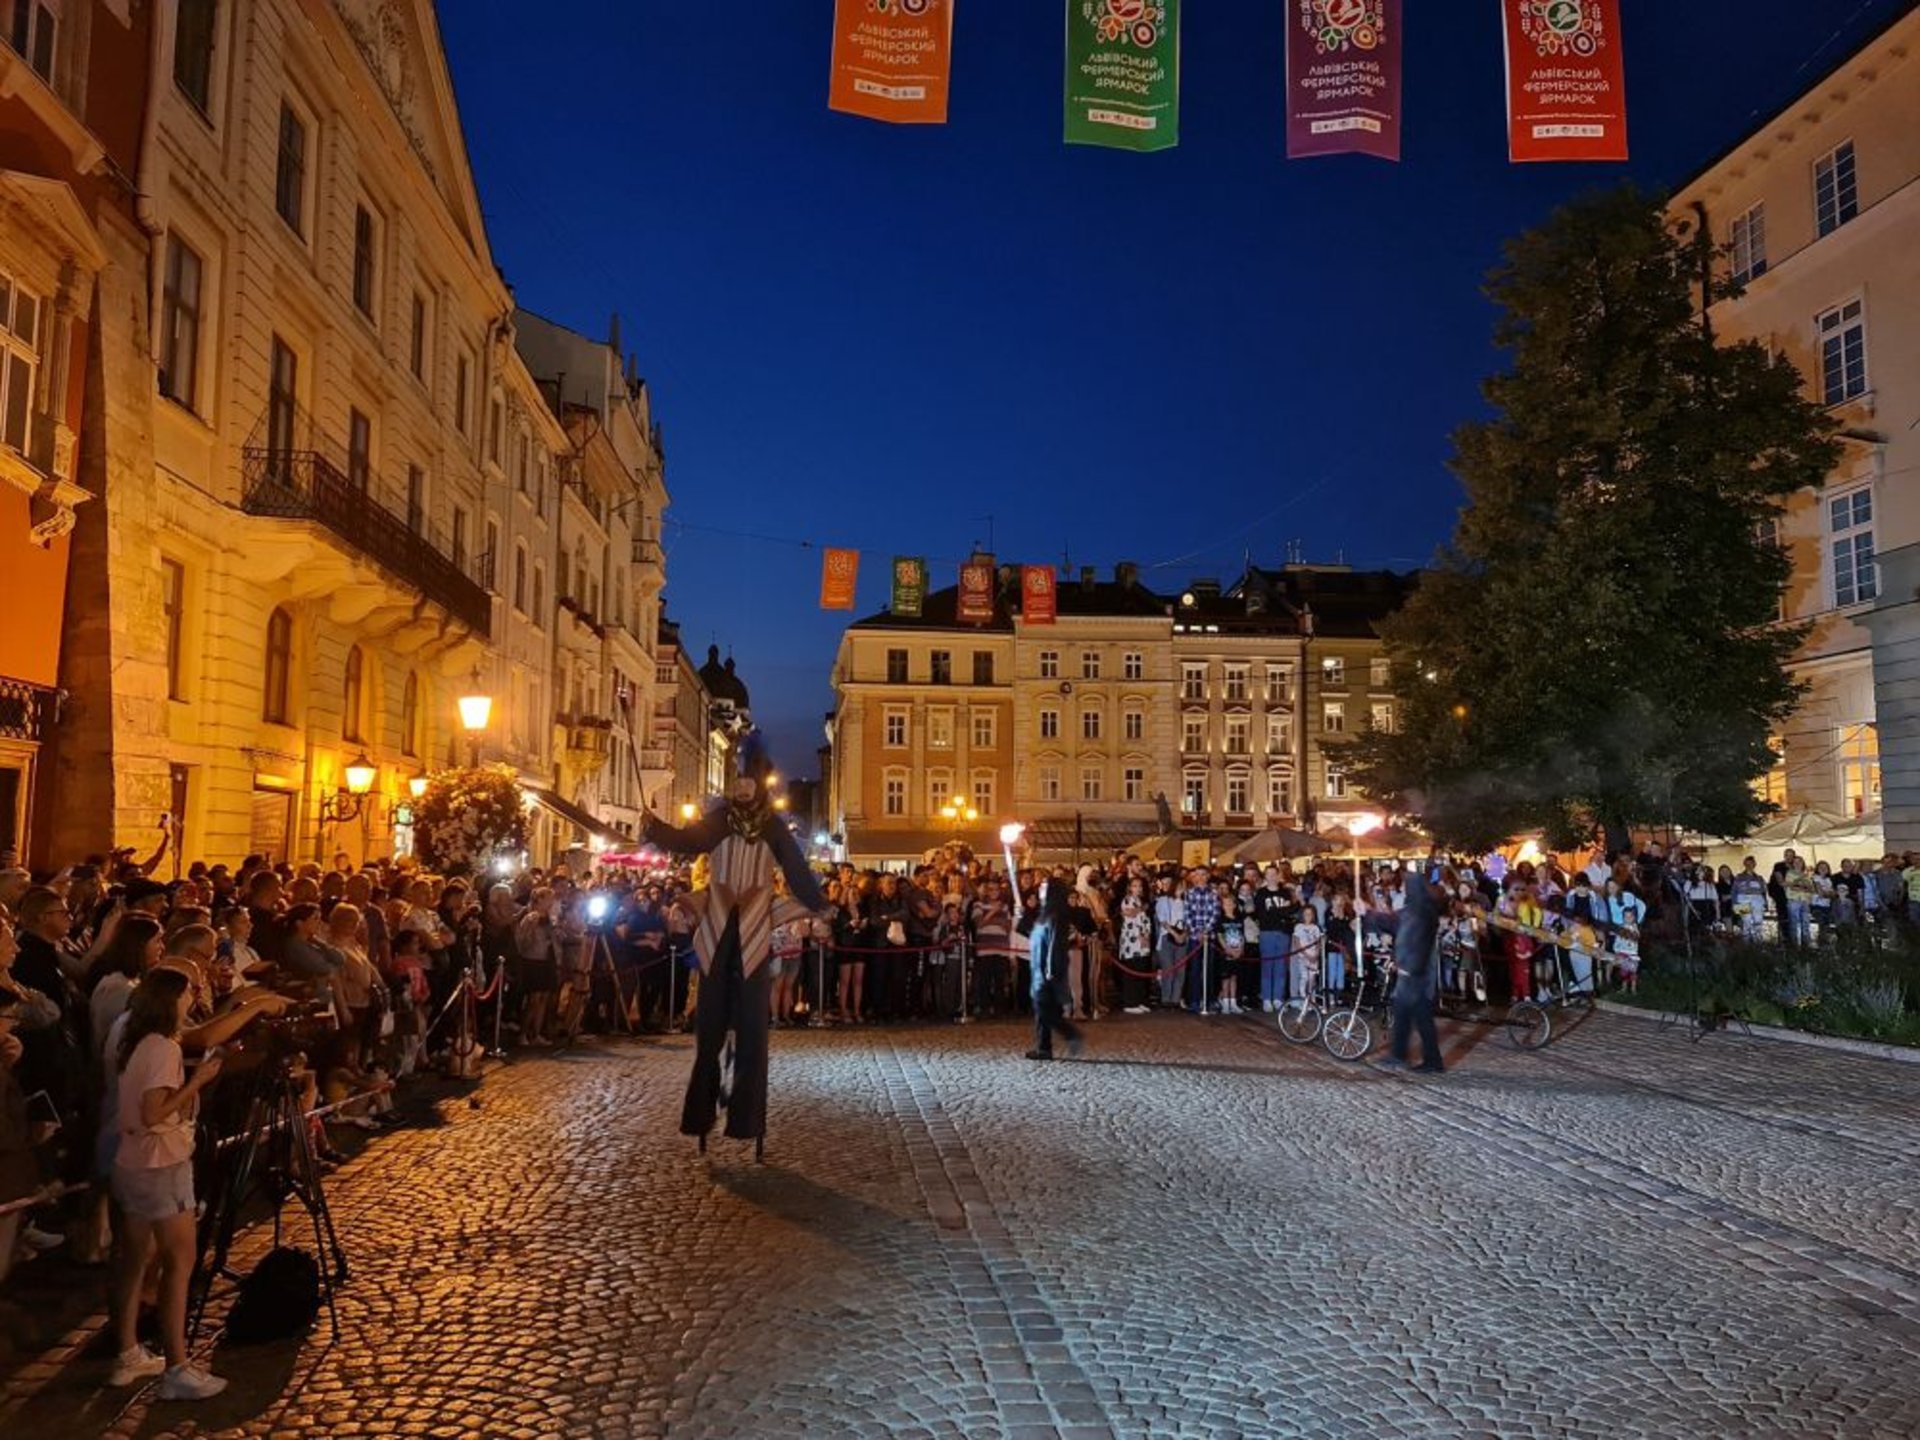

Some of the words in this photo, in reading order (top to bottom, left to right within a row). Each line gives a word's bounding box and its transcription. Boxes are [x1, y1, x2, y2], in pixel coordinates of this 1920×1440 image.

[862, 49, 920, 64] ЯРМАРОК
[1088, 53, 1158, 69] ЛЬВІВСЬКИЙ
[1309, 61, 1379, 75] ЛЬВІВСЬКИЙ
[1531, 66, 1602, 79] ЛЬВІВСЬКИЙ
[1095, 78, 1150, 95] ЯРМАРОК
[1301, 72, 1386, 87] ФЕРМЕРСЬКИЙ
[1523, 80, 1610, 92] ФЕРМЕРСЬКИЙ
[1317, 85, 1375, 100] ЯРМАРОК
[1539, 94, 1596, 104] ЯРМАРОК
